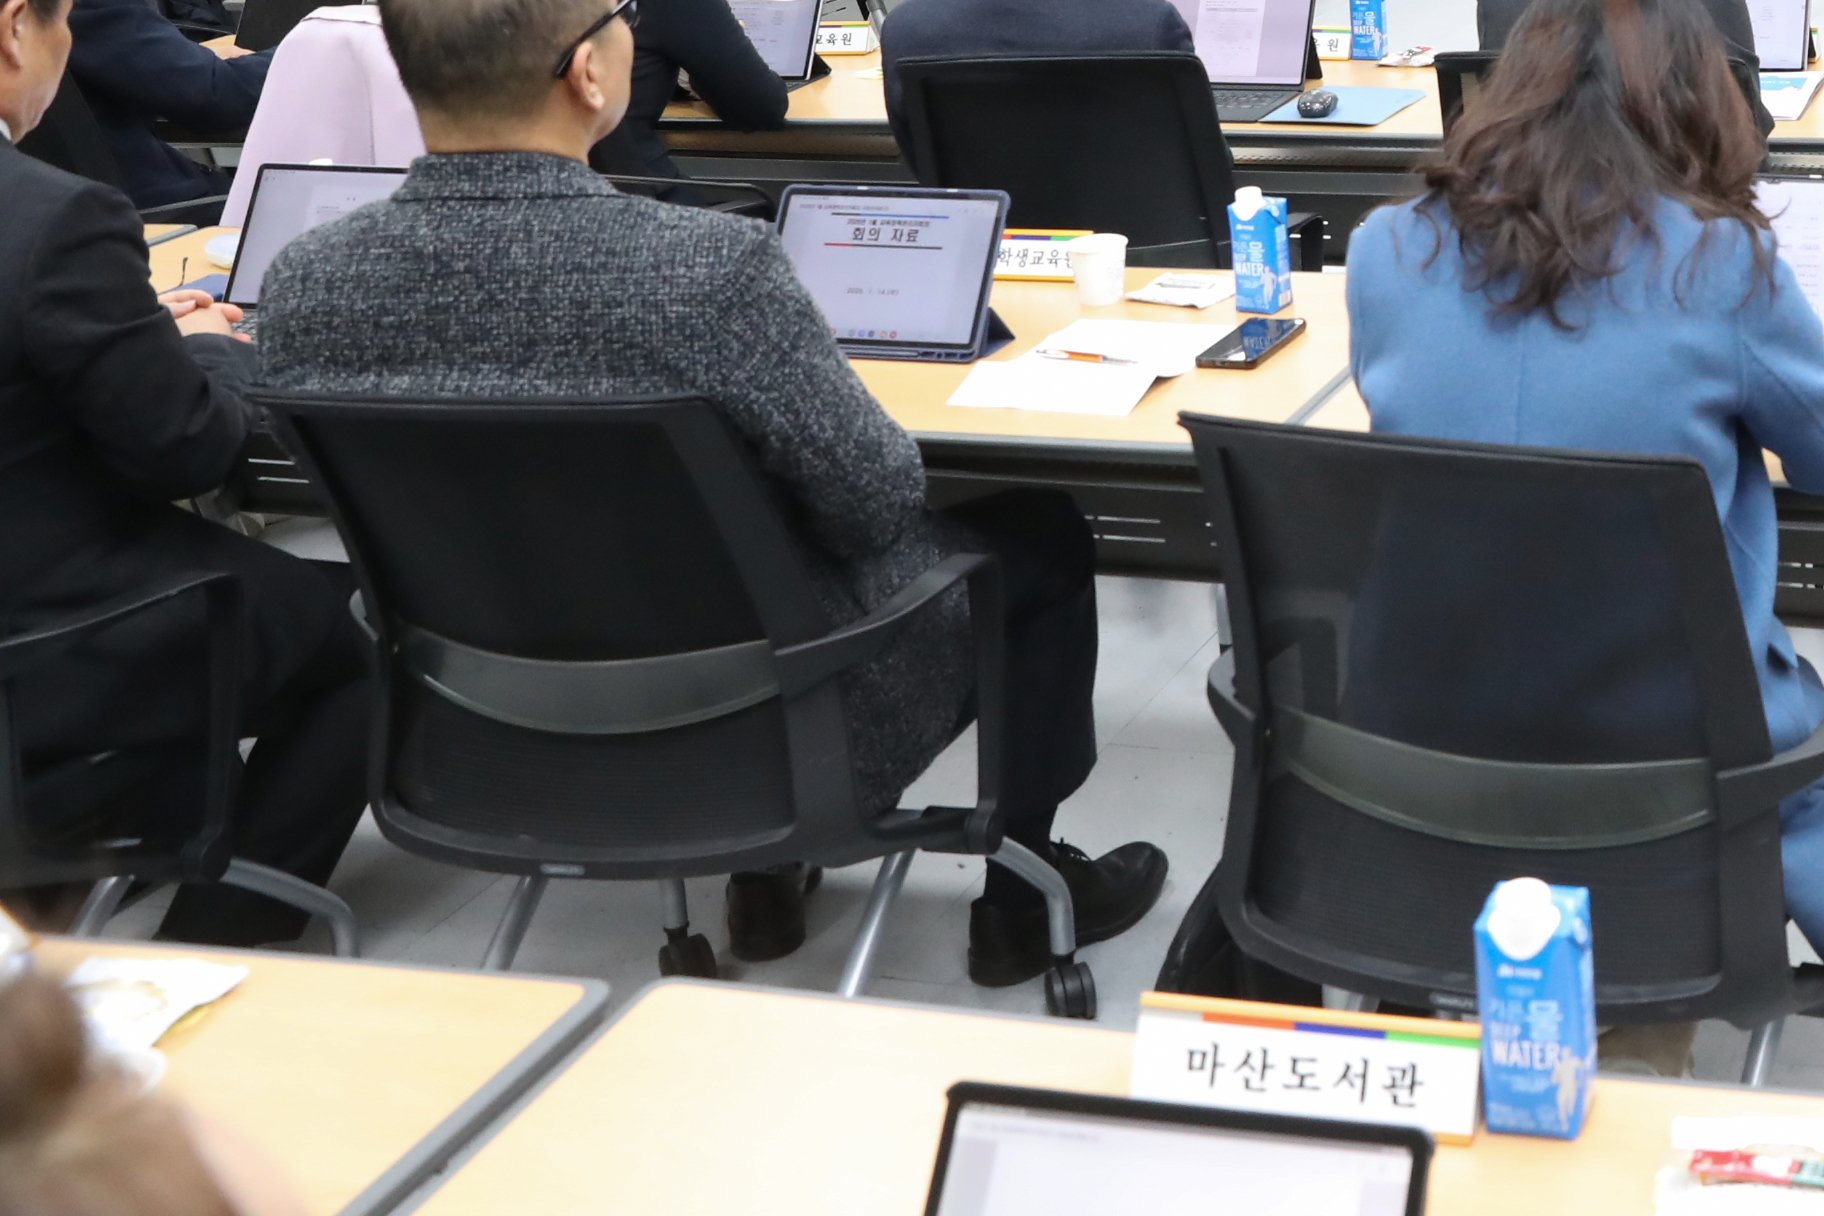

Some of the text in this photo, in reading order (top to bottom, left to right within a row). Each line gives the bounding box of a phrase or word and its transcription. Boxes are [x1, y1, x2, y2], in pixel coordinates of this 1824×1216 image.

[1354, 25, 1375, 36] WATER
[852, 227, 919, 243] 회의 자료
[1235, 262, 1265, 277] WATER
[1491, 1039, 1561, 1071] WATER
[1186, 1041, 1427, 1109] 마산도서관
